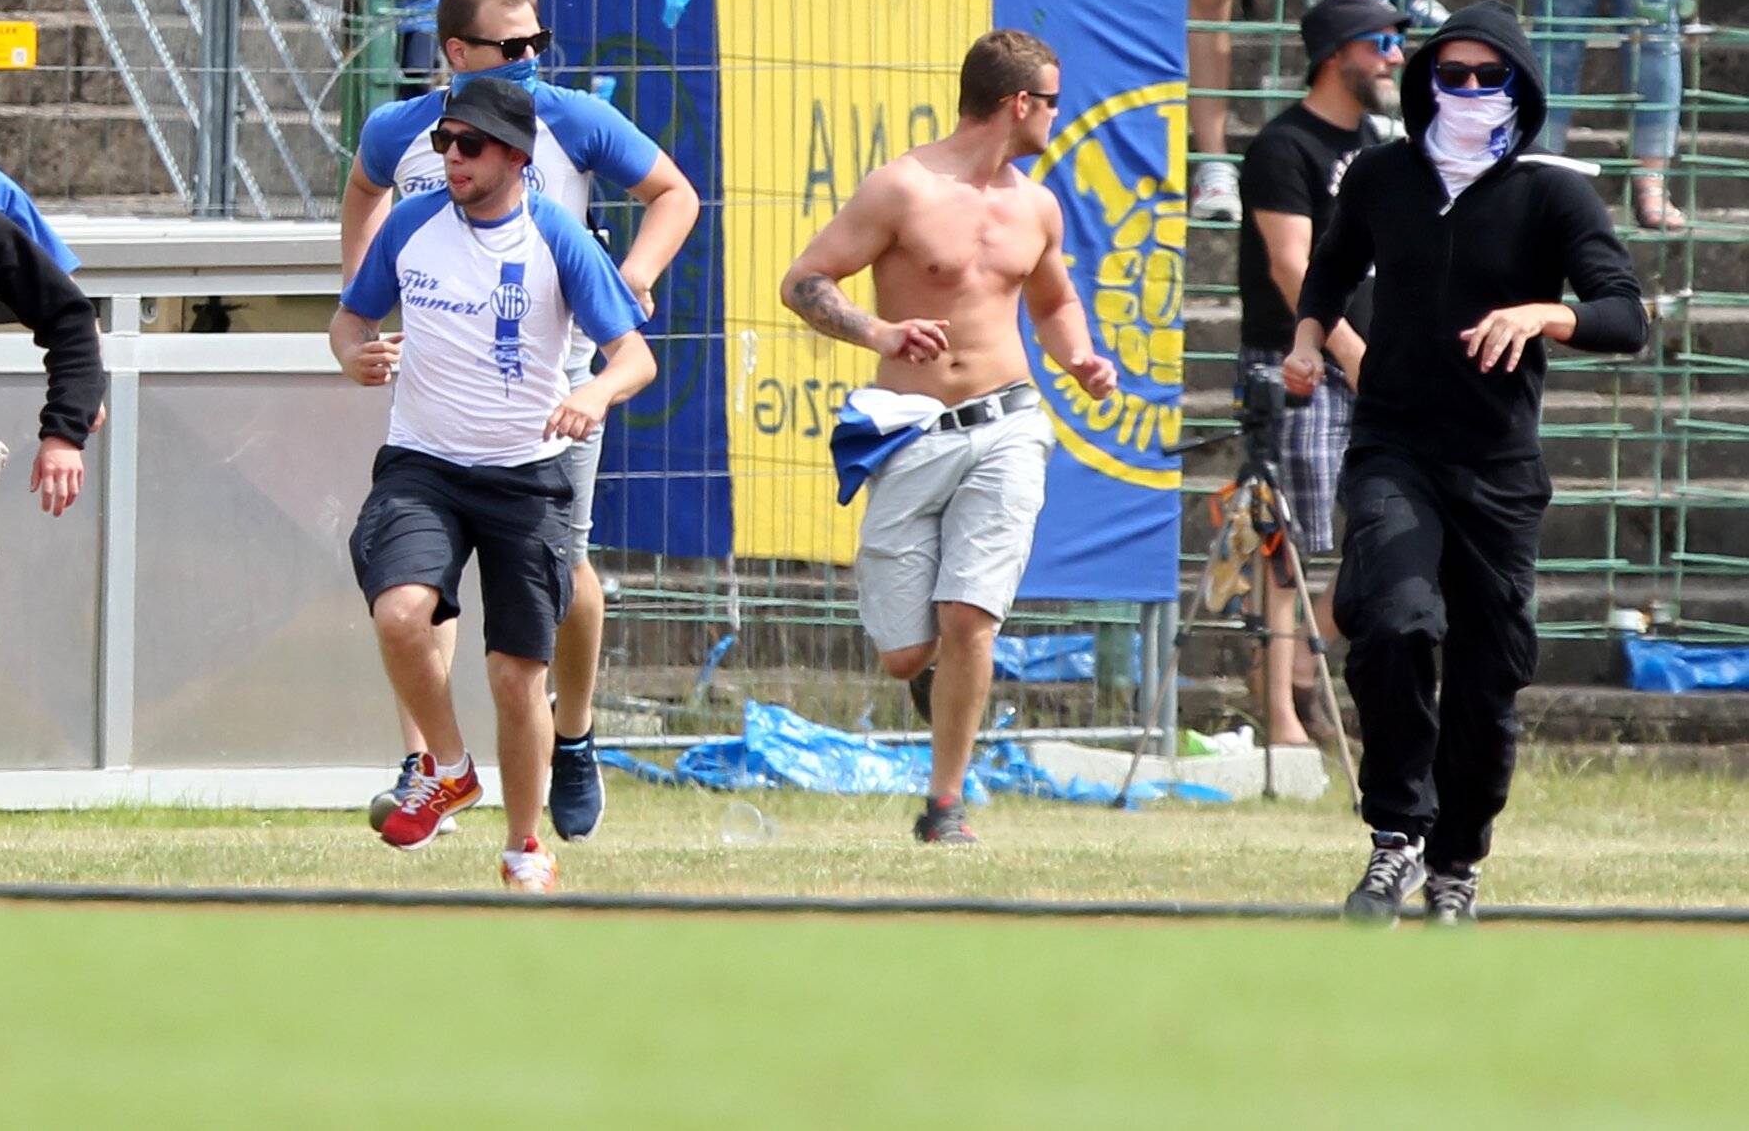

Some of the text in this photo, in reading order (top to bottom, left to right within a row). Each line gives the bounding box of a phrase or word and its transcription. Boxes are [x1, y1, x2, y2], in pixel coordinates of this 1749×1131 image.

[399, 269, 439, 290] Für
[404, 288, 489, 316] immer!
[492, 284, 526, 319] VfB
